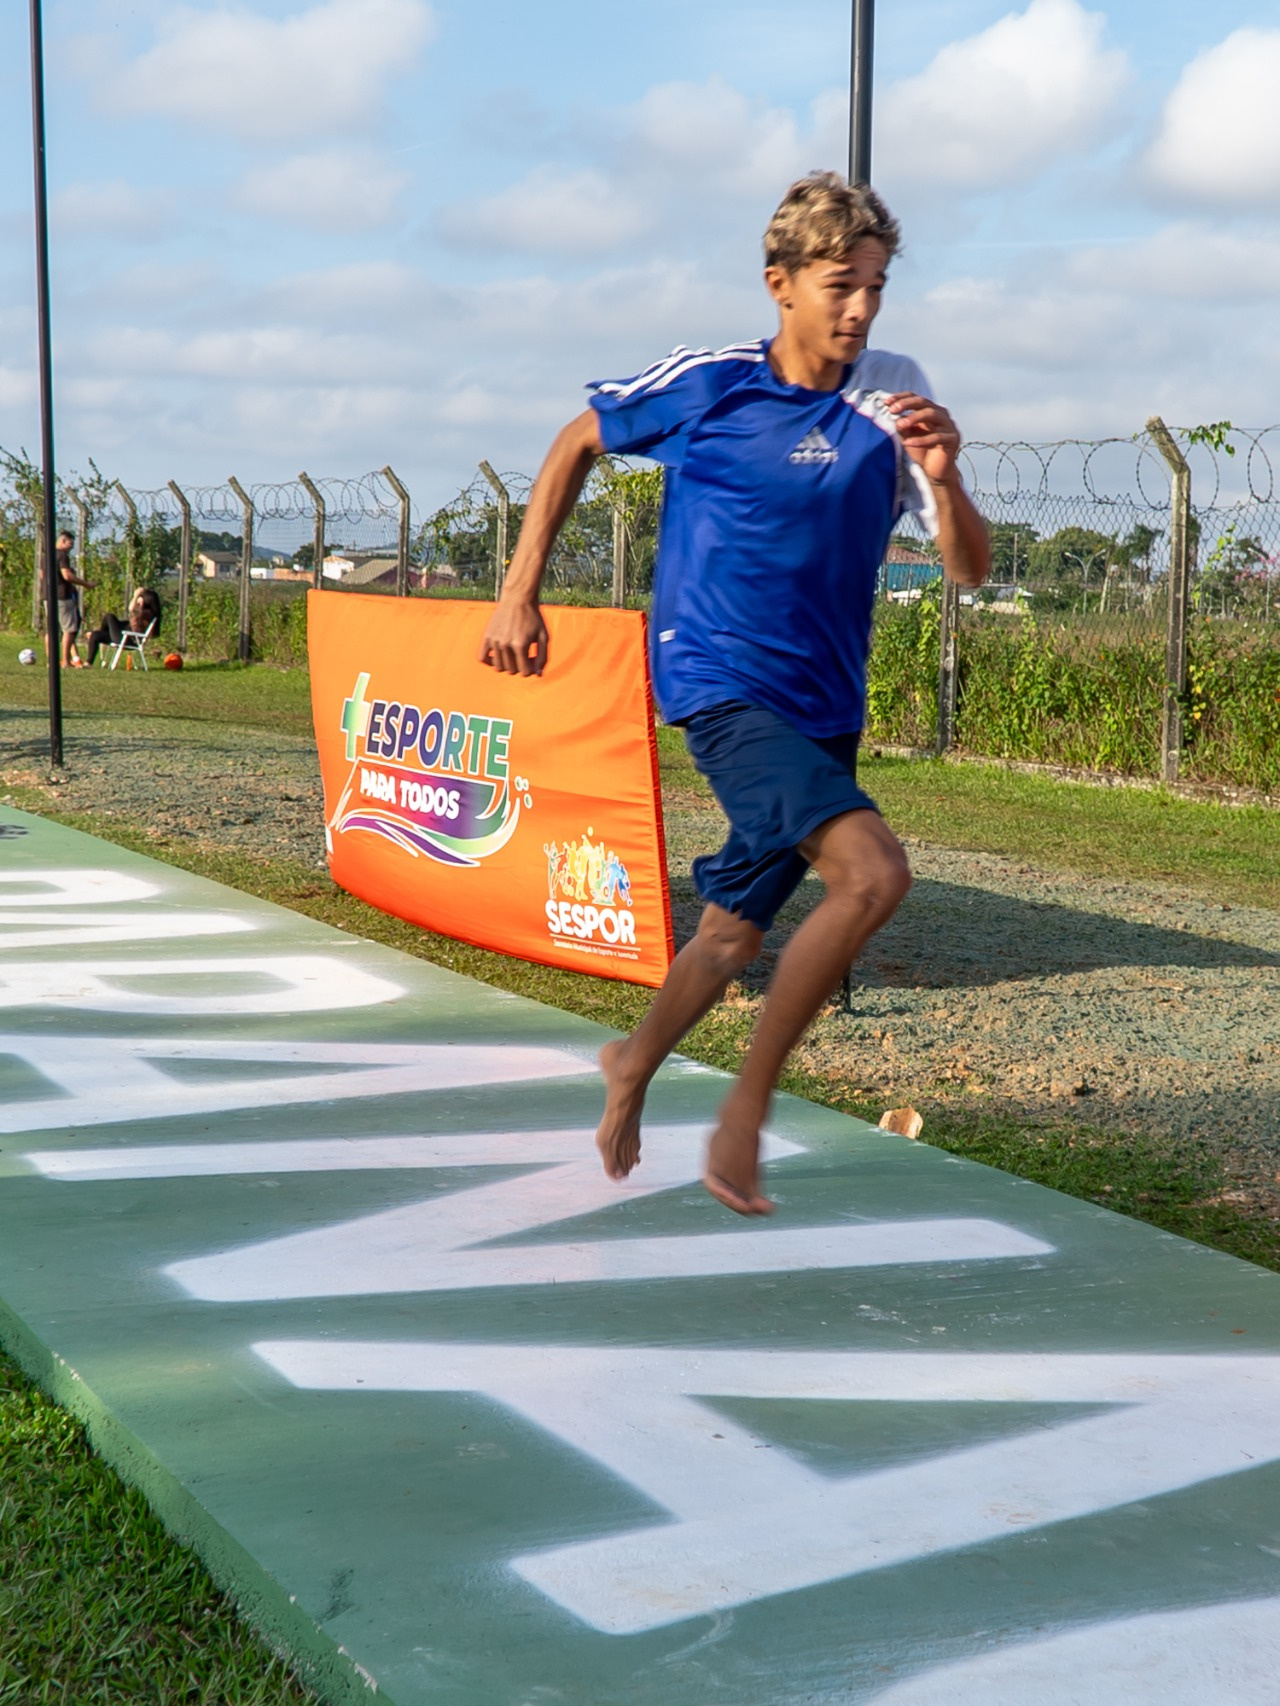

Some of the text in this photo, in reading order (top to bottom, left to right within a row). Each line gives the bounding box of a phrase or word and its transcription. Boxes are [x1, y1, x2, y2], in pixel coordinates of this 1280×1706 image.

[366, 699, 513, 781] ESPORTE
[360, 768, 460, 820] PARA TODOS
[545, 900, 636, 945] SESPOR
